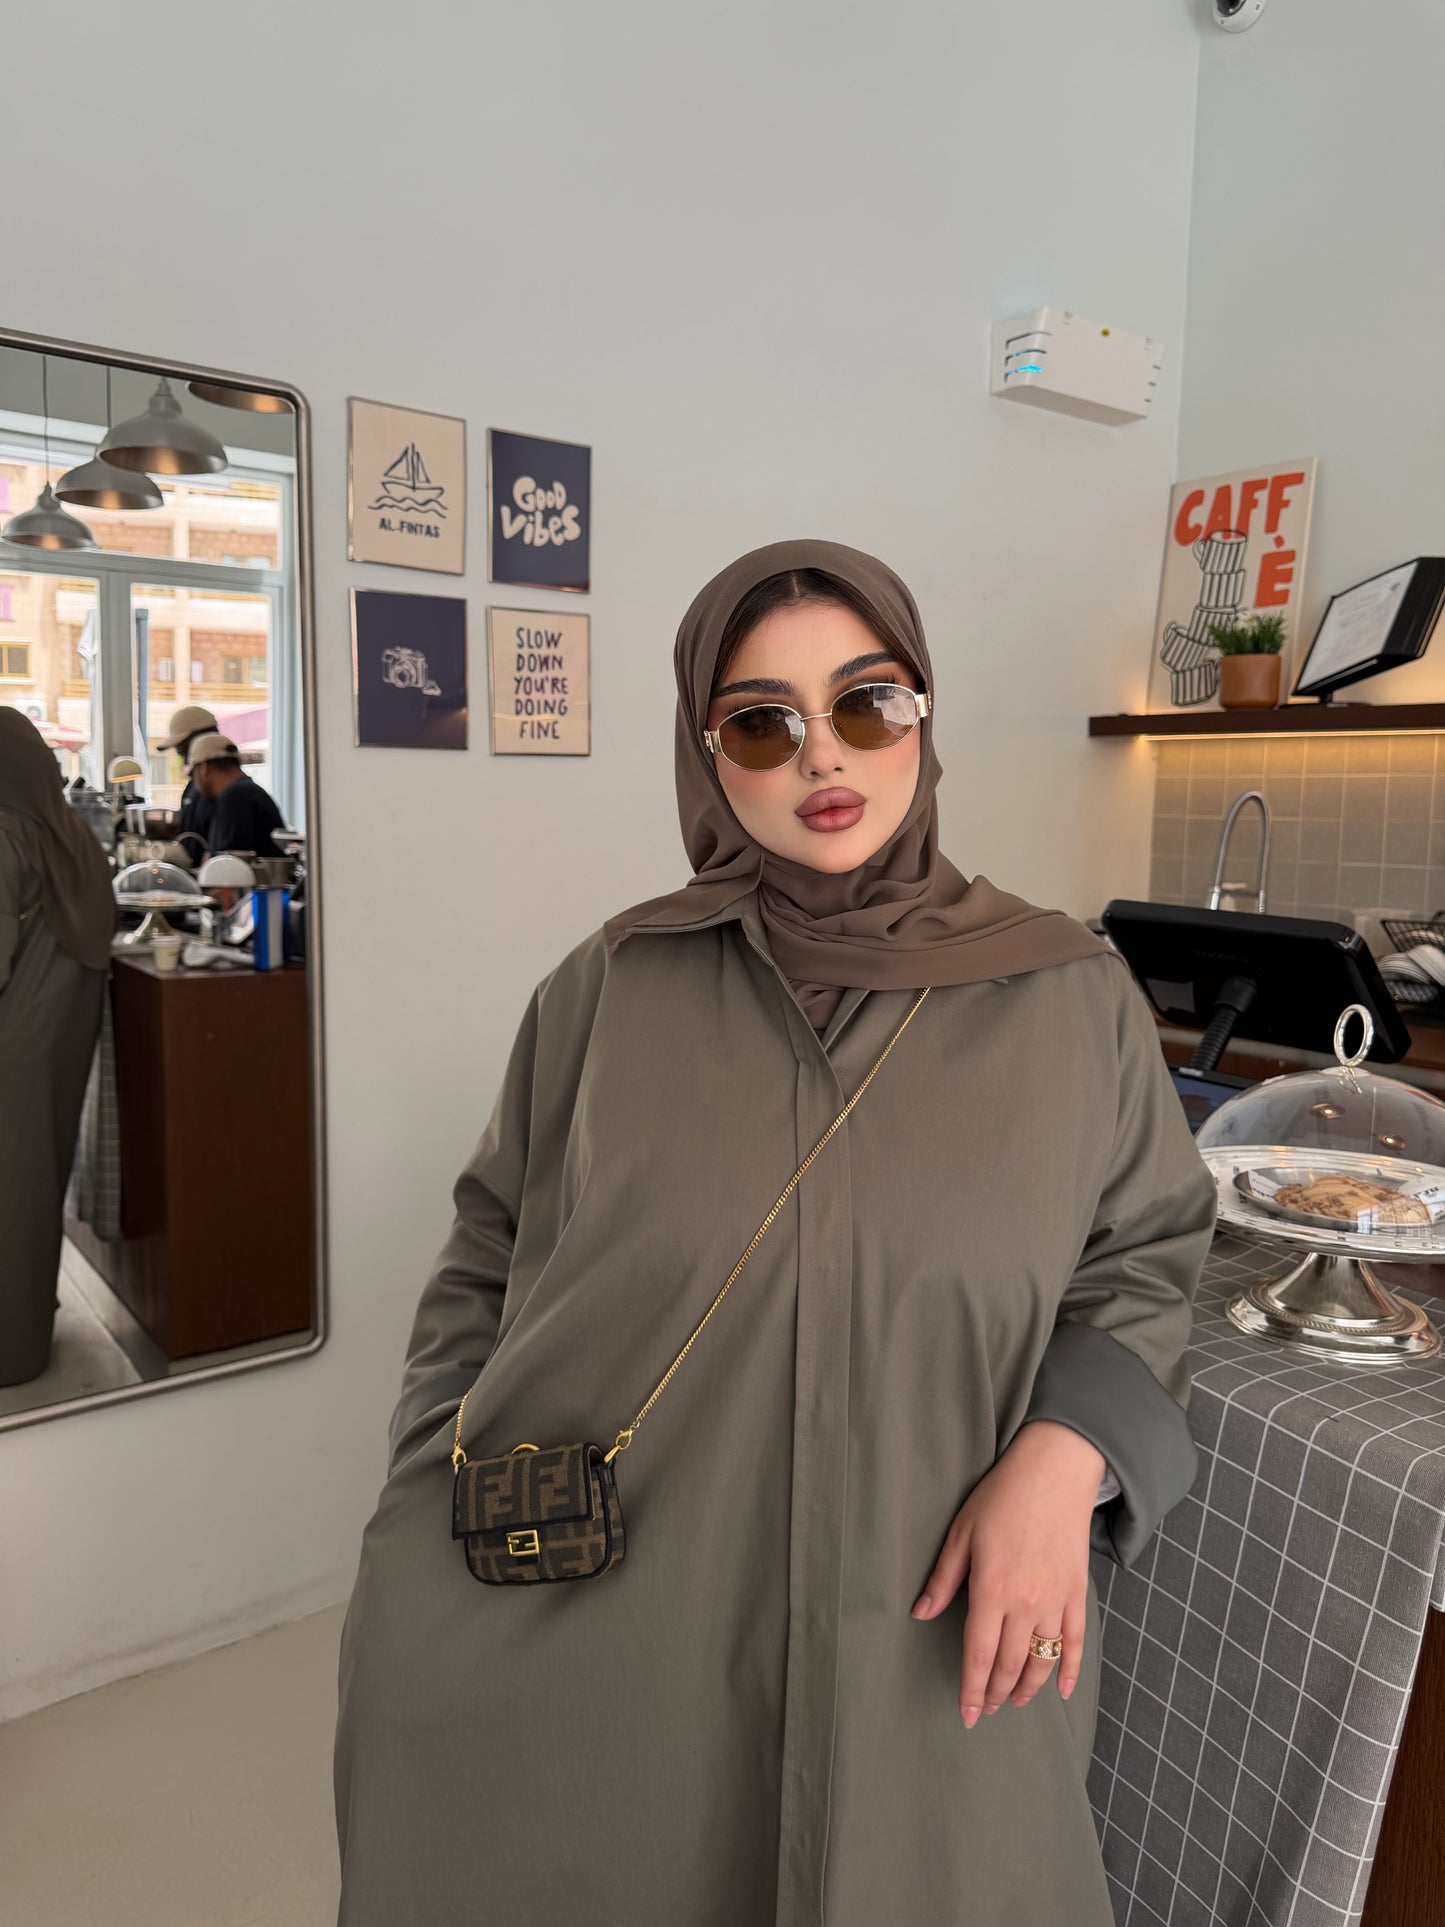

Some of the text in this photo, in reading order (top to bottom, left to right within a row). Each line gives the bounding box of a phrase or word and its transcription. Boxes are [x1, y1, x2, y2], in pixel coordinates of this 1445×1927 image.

[516, 627, 562, 649] SLOW
[516, 653, 563, 673] DOWN
[514, 676, 568, 696] YOU'RE
[515, 698, 568, 717] DOING
[519, 720, 560, 740] FINE
